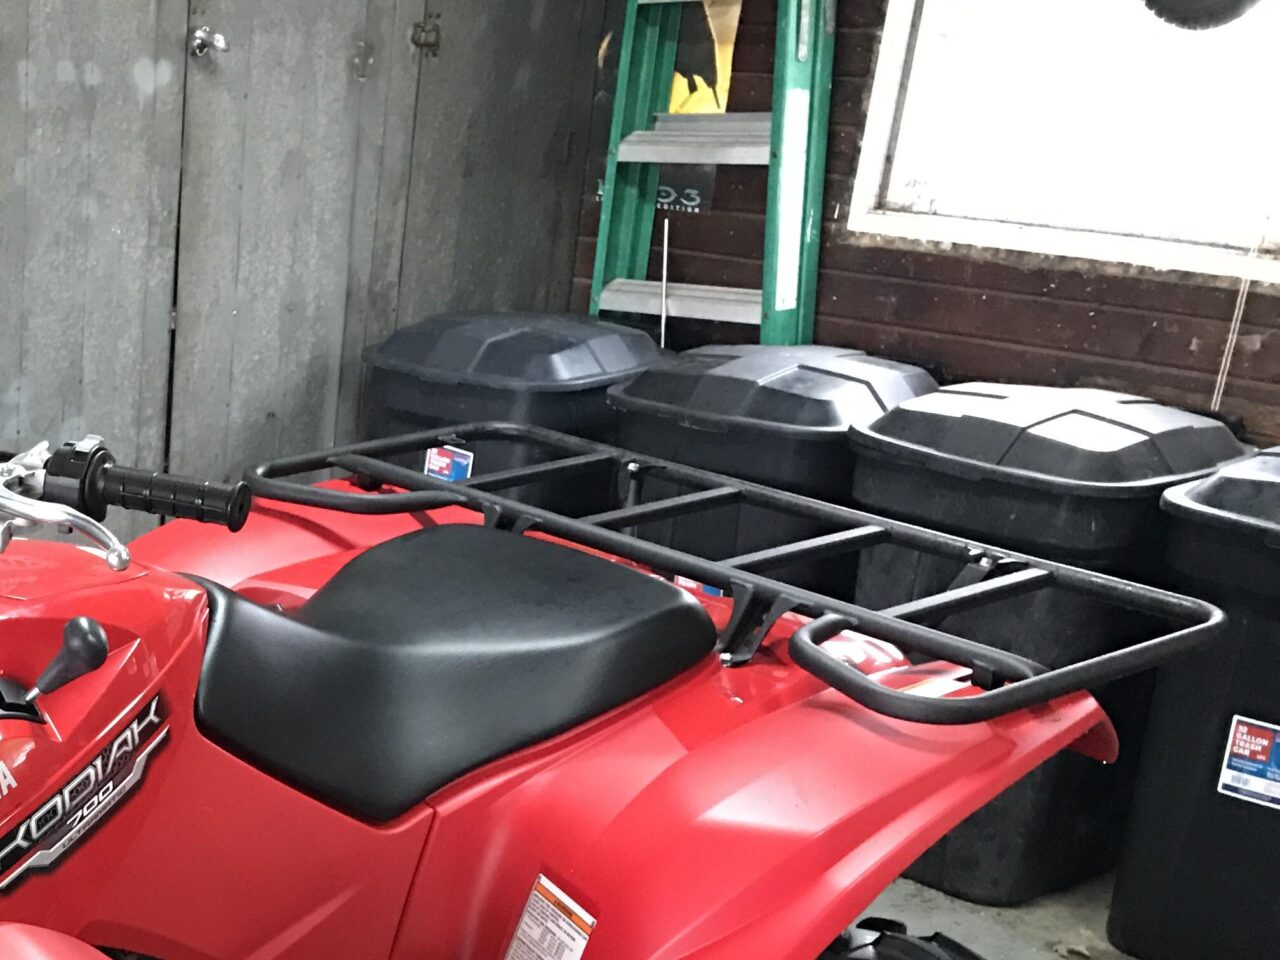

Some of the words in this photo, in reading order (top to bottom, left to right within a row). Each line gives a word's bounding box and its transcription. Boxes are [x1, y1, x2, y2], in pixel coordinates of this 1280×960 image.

[1235, 739, 1262, 752] TRASH
[1236, 732, 1269, 747] GALLON
[1233, 746, 1251, 757] CAN
[66, 780, 114, 827] 700
